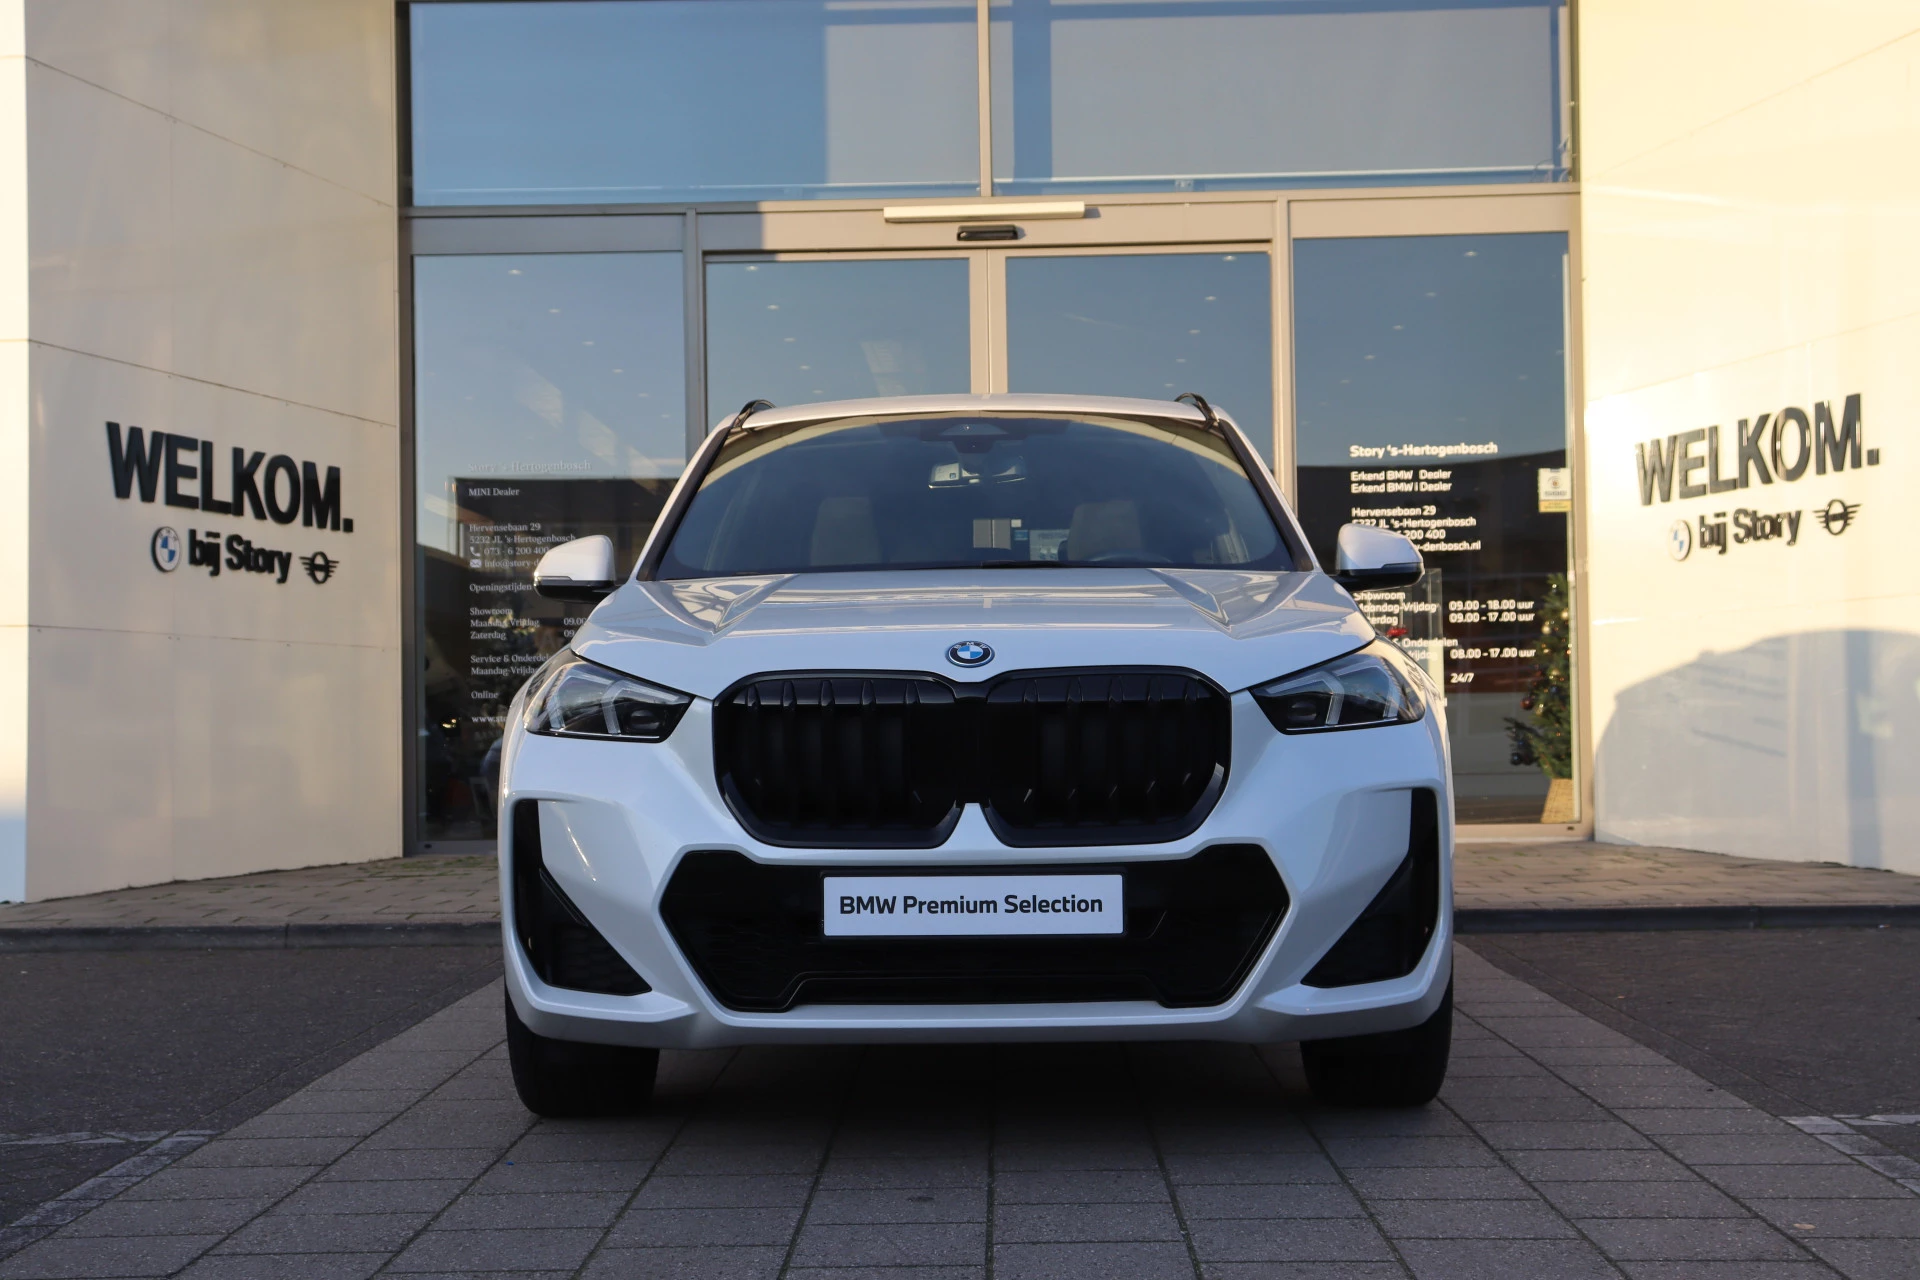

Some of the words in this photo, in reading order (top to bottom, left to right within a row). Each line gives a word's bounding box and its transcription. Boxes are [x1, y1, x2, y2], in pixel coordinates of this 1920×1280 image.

[1349, 444, 1385, 459] Story
[1386, 441, 1498, 458] 's-Hertogenbosch
[1634, 392, 1880, 506] WELKOM.
[106, 420, 354, 533] WELKOM.
[1350, 471, 1386, 482] Erkend
[1386, 470, 1413, 481] BMW
[1418, 469, 1452, 480] Dealer
[468, 488, 491, 496] MINI
[492, 487, 520, 496] Dealer
[1350, 483, 1386, 494] Erkend
[1386, 482, 1413, 493] BMW
[1419, 481, 1452, 492] Dealer
[1351, 506, 1422, 517] Hervensebaan
[1422, 505, 1437, 516] 29
[469, 523, 528, 533] Hervensebaan
[529, 522, 541, 532] 29
[1699, 512, 1727, 555] bij
[1732, 508, 1803, 546] Story
[1424, 529, 1446, 539] 400
[469, 535, 490, 545] 5232
[492, 535, 503, 544] JL
[188, 528, 221, 577] bij
[225, 534, 292, 584] Story
[483, 547, 500, 556] 073
[507, 547, 514, 555] 6
[516, 547, 532, 555] 200
[533, 546, 550, 555] 400
[469, 583, 532, 593] Openingstijden
[1449, 600, 1480, 611] 09.00
[1487, 599, 1516, 610] 18.00
[1517, 601, 1535, 610] uur
[469, 607, 513, 616] Showroom
[1449, 612, 1480, 623] 09.00
[1517, 612, 1535, 622] uur
[470, 630, 507, 640] Zaterdag
[1402, 637, 1459, 648] Onderdelen
[470, 654, 501, 664] Service
[1450, 648, 1481, 659] 08.00
[1518, 648, 1536, 658] uur
[1450, 672, 1475, 684] 24/7
[470, 690, 499, 700] Online
[839, 895, 897, 915] BMW
[903, 895, 998, 914] Premium
[1003, 894, 1103, 914] Selection
